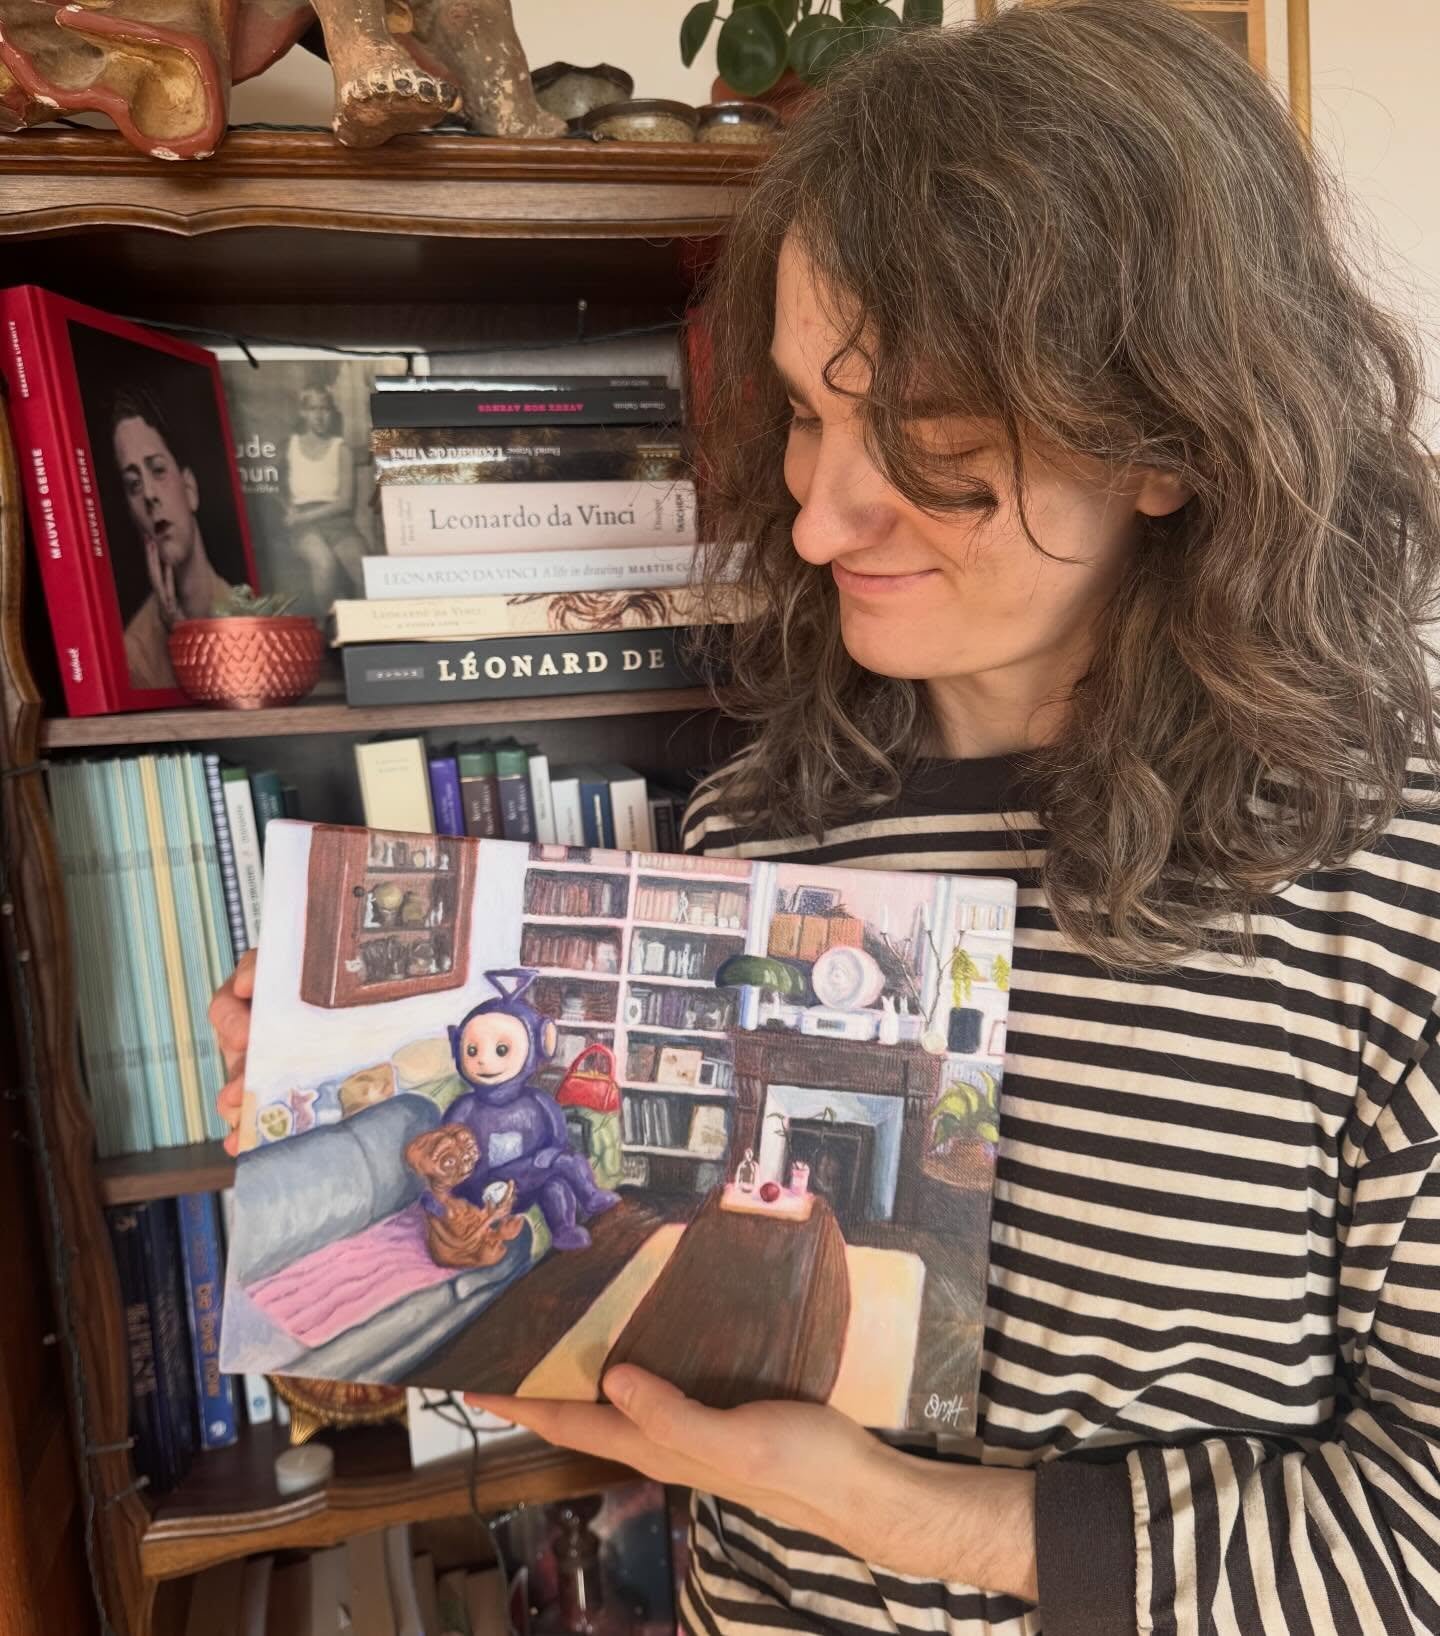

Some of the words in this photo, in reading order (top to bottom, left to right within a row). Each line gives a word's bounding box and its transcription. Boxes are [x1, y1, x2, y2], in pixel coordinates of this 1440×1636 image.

[32, 449, 49, 494] GENRE
[41, 498, 62, 559] MAUVAIS
[430, 504, 541, 531] Leonardo
[547, 503, 573, 528] da
[578, 503, 636, 526] Vinci
[384, 568, 470, 586] LEONARDO
[496, 566, 538, 580] VINCI
[628, 563, 672, 575] MARTIN
[437, 651, 609, 681] LÉONARD
[622, 649, 666, 670] DE
[196, 1282, 214, 1309] be
[198, 1312, 217, 1355] love
